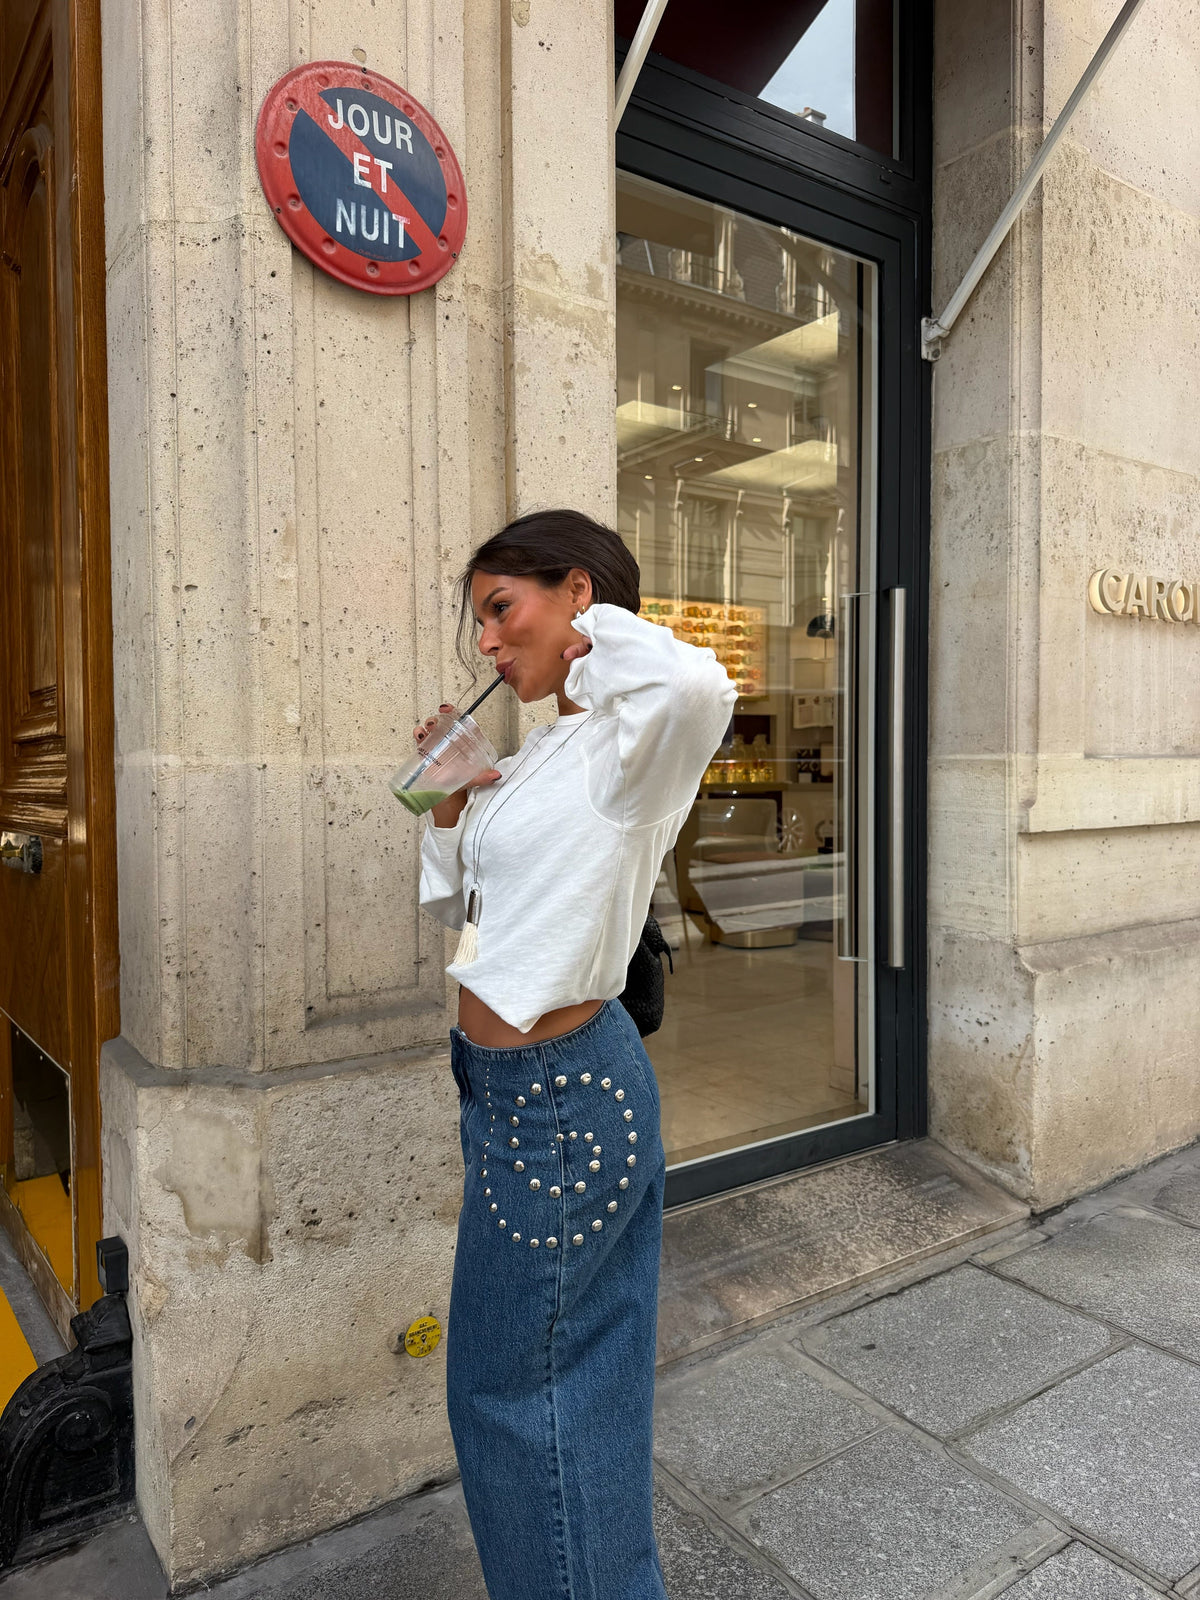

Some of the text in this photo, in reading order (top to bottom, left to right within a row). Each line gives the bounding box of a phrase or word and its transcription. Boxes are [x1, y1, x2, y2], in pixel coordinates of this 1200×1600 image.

[328, 98, 414, 154] JOUR
[353, 152, 393, 193] ET
[336, 198, 411, 248] NUIT
[1088, 568, 1200, 624] CARO
